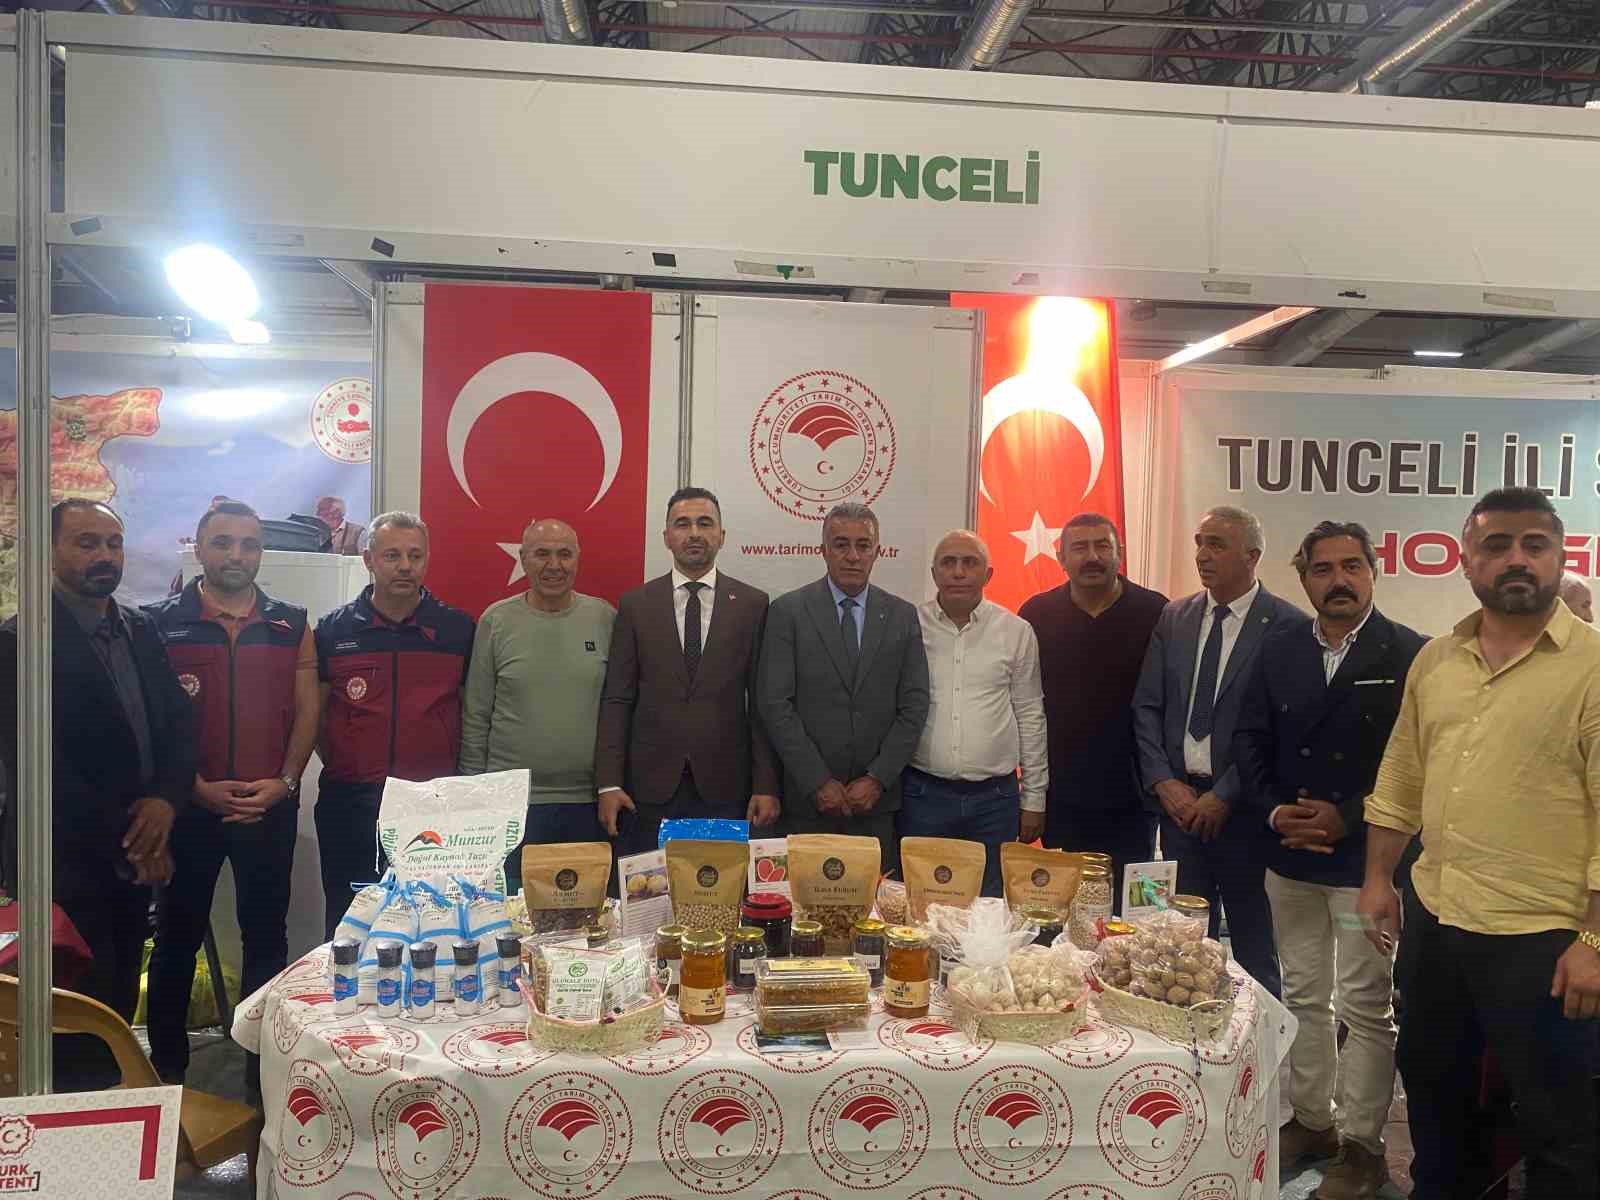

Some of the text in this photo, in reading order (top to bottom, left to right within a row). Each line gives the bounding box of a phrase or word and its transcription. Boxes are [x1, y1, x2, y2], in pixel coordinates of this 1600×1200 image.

[803, 149, 1040, 205] TUNCELİ
[812, 393, 841, 403] TARIM
[844, 400, 856, 410] VE
[856, 410, 874, 445] ORMAN
[1218, 432, 1479, 496] TUNCELİ
[1502, 433, 1575, 497] İLİ
[1375, 532, 1463, 576] HO
[446, 834, 496, 848] Munzur
